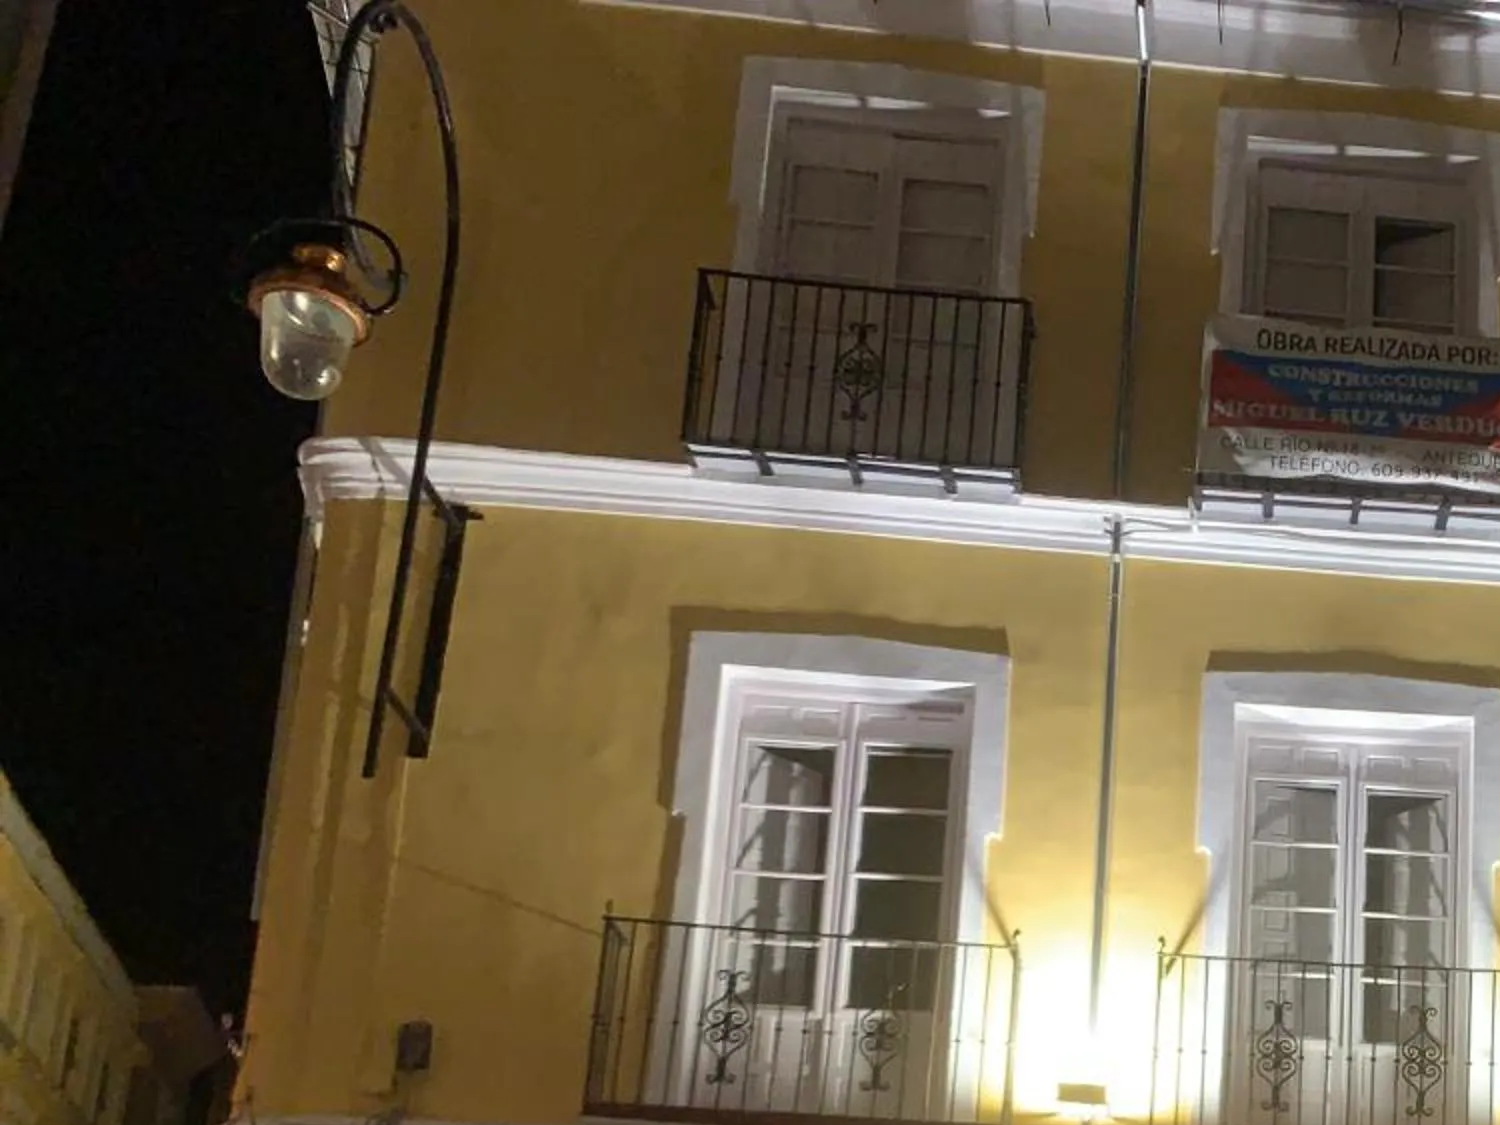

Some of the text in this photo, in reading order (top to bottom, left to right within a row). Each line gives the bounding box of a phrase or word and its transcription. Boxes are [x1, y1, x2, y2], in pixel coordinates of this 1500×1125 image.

[1257, 328, 1499, 366] OBRA REALIZADA POR:
[1268, 363, 1479, 394] CONSTRUCCIONES
